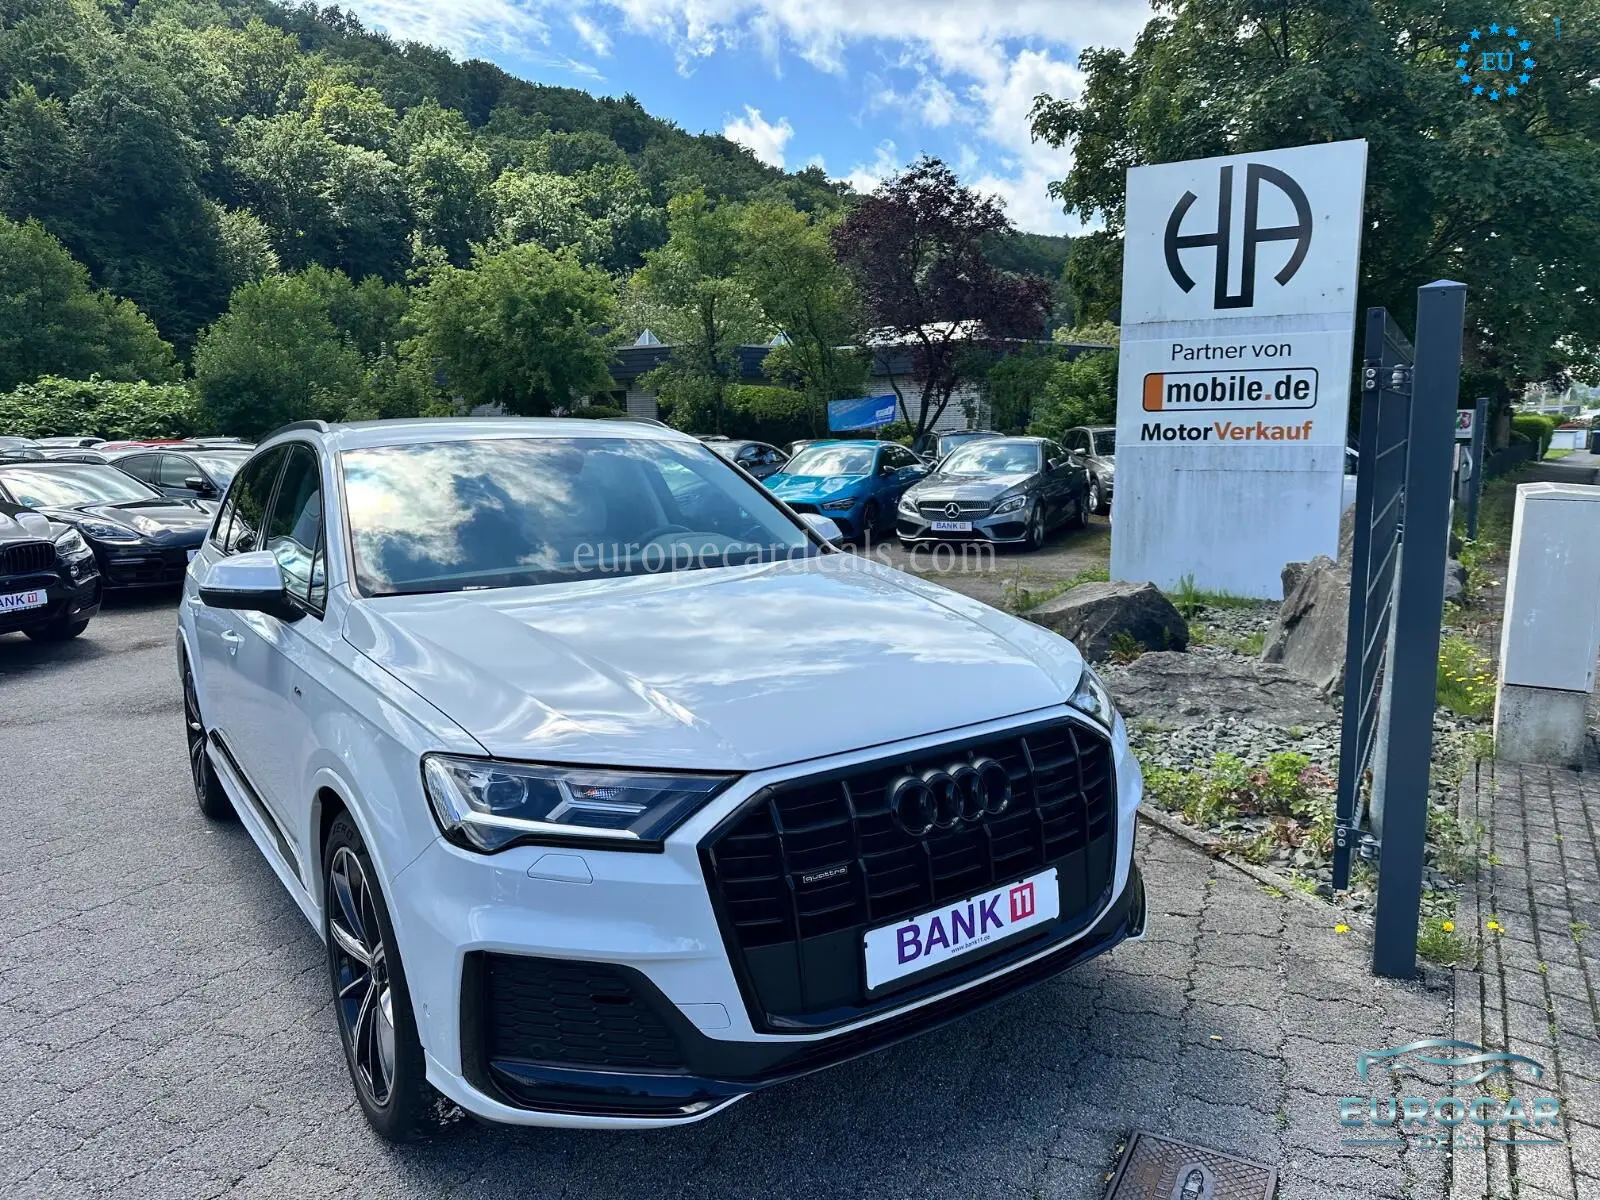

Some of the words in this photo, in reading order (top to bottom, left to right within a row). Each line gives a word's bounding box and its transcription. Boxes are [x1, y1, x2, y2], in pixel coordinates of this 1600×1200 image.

[1171, 342, 1248, 361] Partner
[1251, 341, 1292, 357] von
[1166, 374, 1311, 403] mobile.de
[896, 893, 1004, 965] BANK
[1012, 885, 1033, 920] 11
